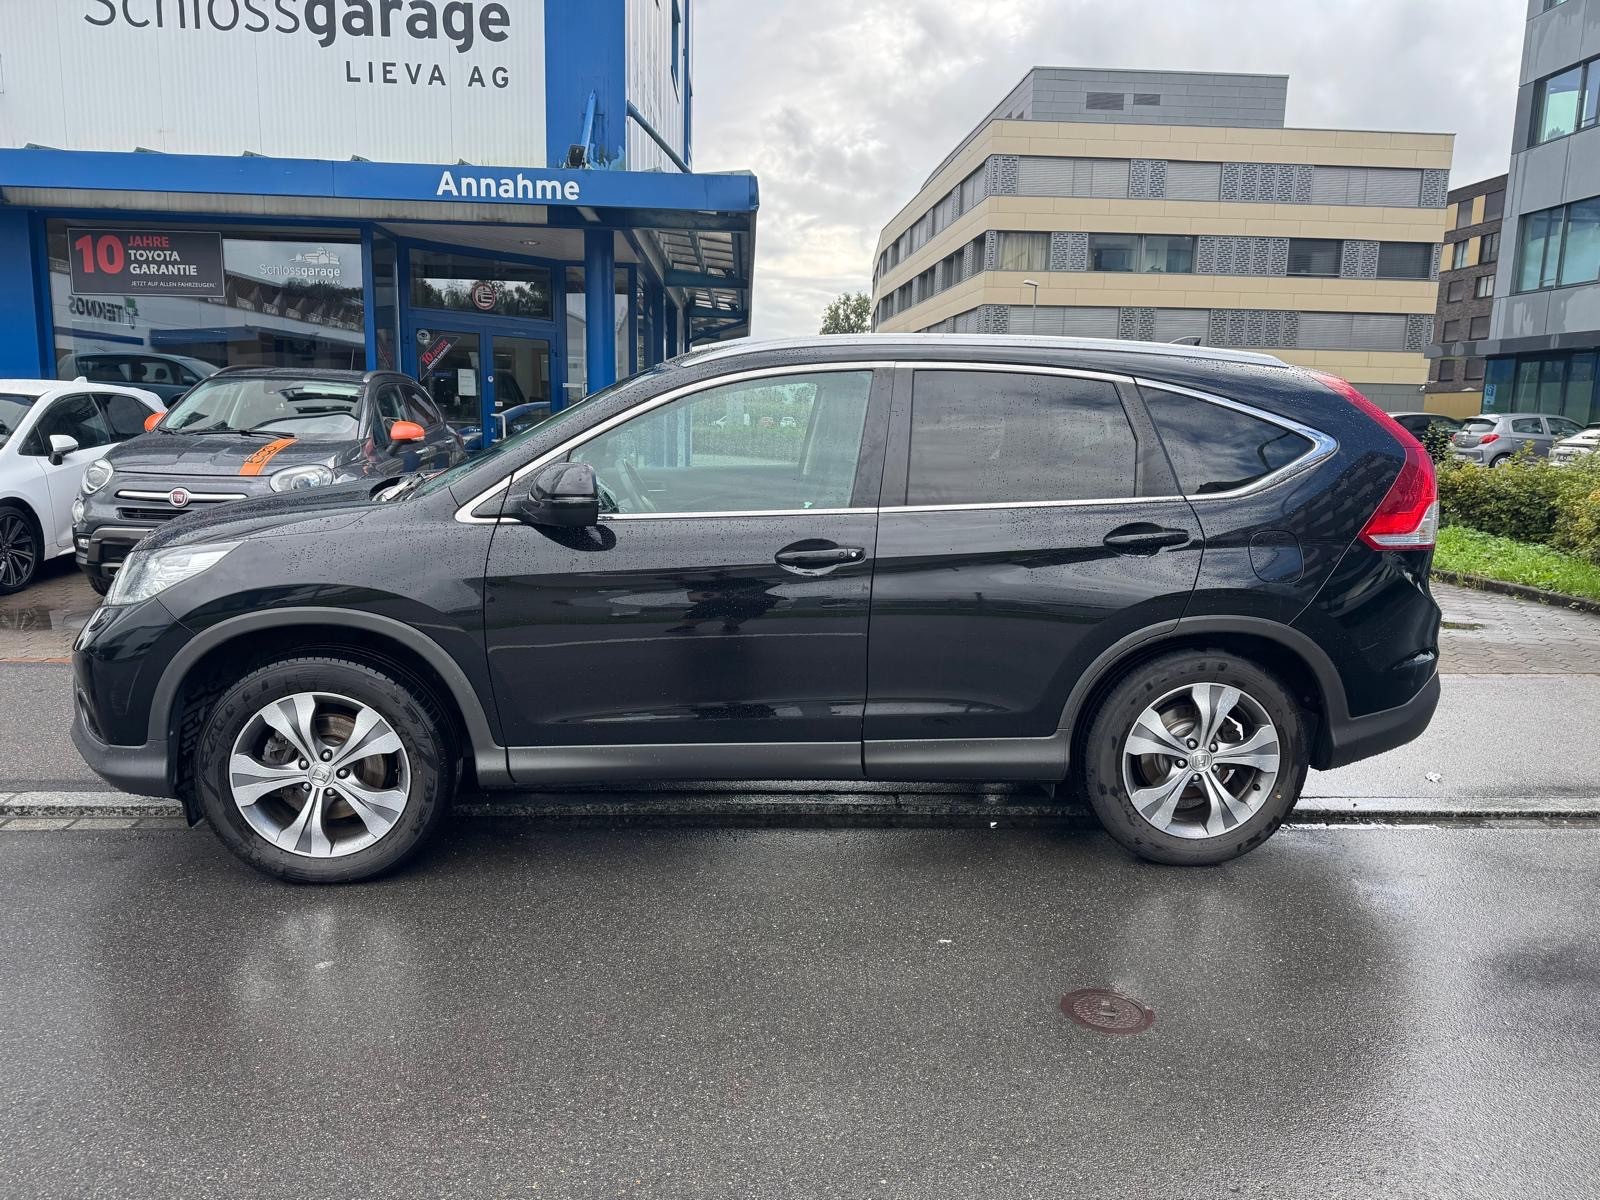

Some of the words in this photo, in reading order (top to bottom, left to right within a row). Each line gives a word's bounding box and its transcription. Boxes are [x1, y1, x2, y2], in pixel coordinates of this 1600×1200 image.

[345, 60, 446, 86] LIEVA
[467, 66, 510, 89] AG
[436, 170, 580, 201] Annahme
[127, 235, 169, 248] JAHRE
[75, 234, 125, 275] 10
[128, 249, 180, 262] TOYOTA
[129, 263, 198, 276] GARANTIE
[259, 263, 341, 279] Schlossgarage
